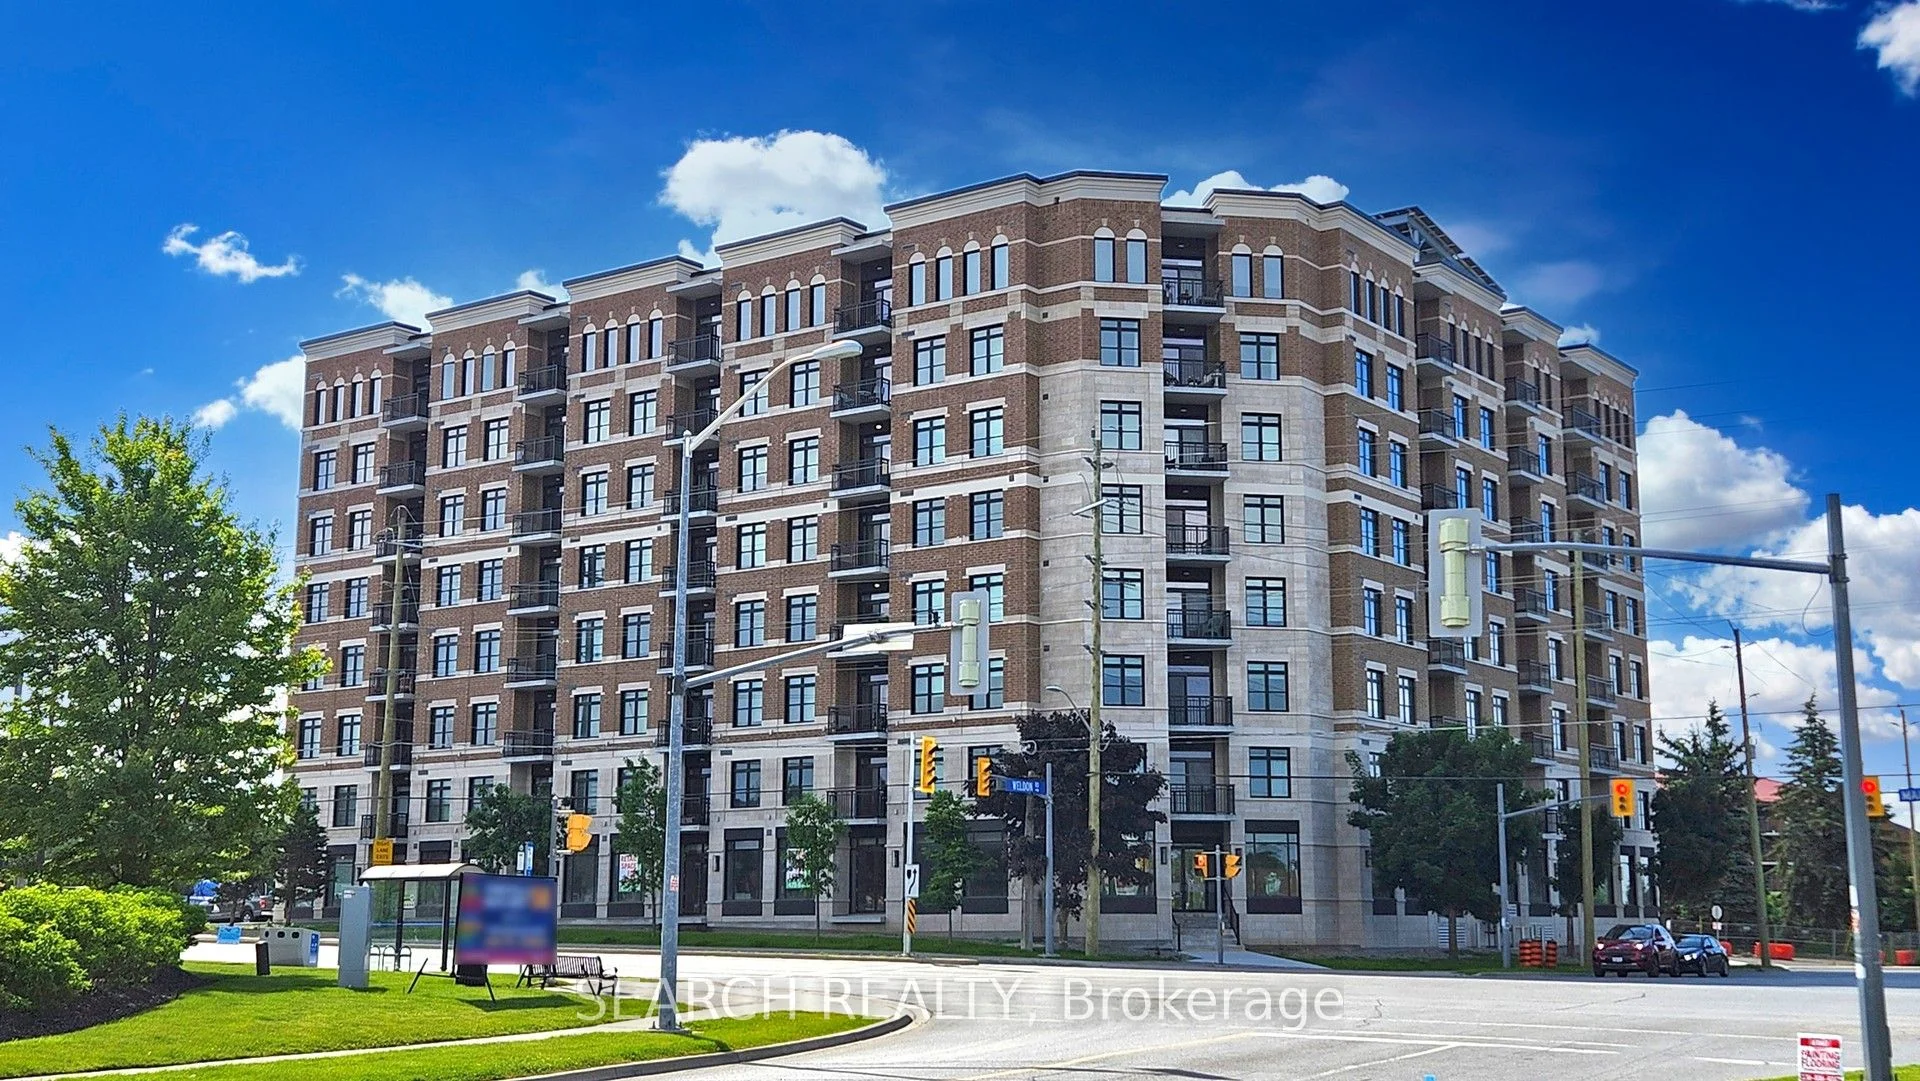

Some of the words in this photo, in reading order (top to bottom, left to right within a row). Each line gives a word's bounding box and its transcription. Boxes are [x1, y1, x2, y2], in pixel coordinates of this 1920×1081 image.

[1012, 780, 1033, 791] WELDON
[1801, 1049, 1841, 1060] PAINTING
[1801, 1058, 1841, 1069] FLOORING
